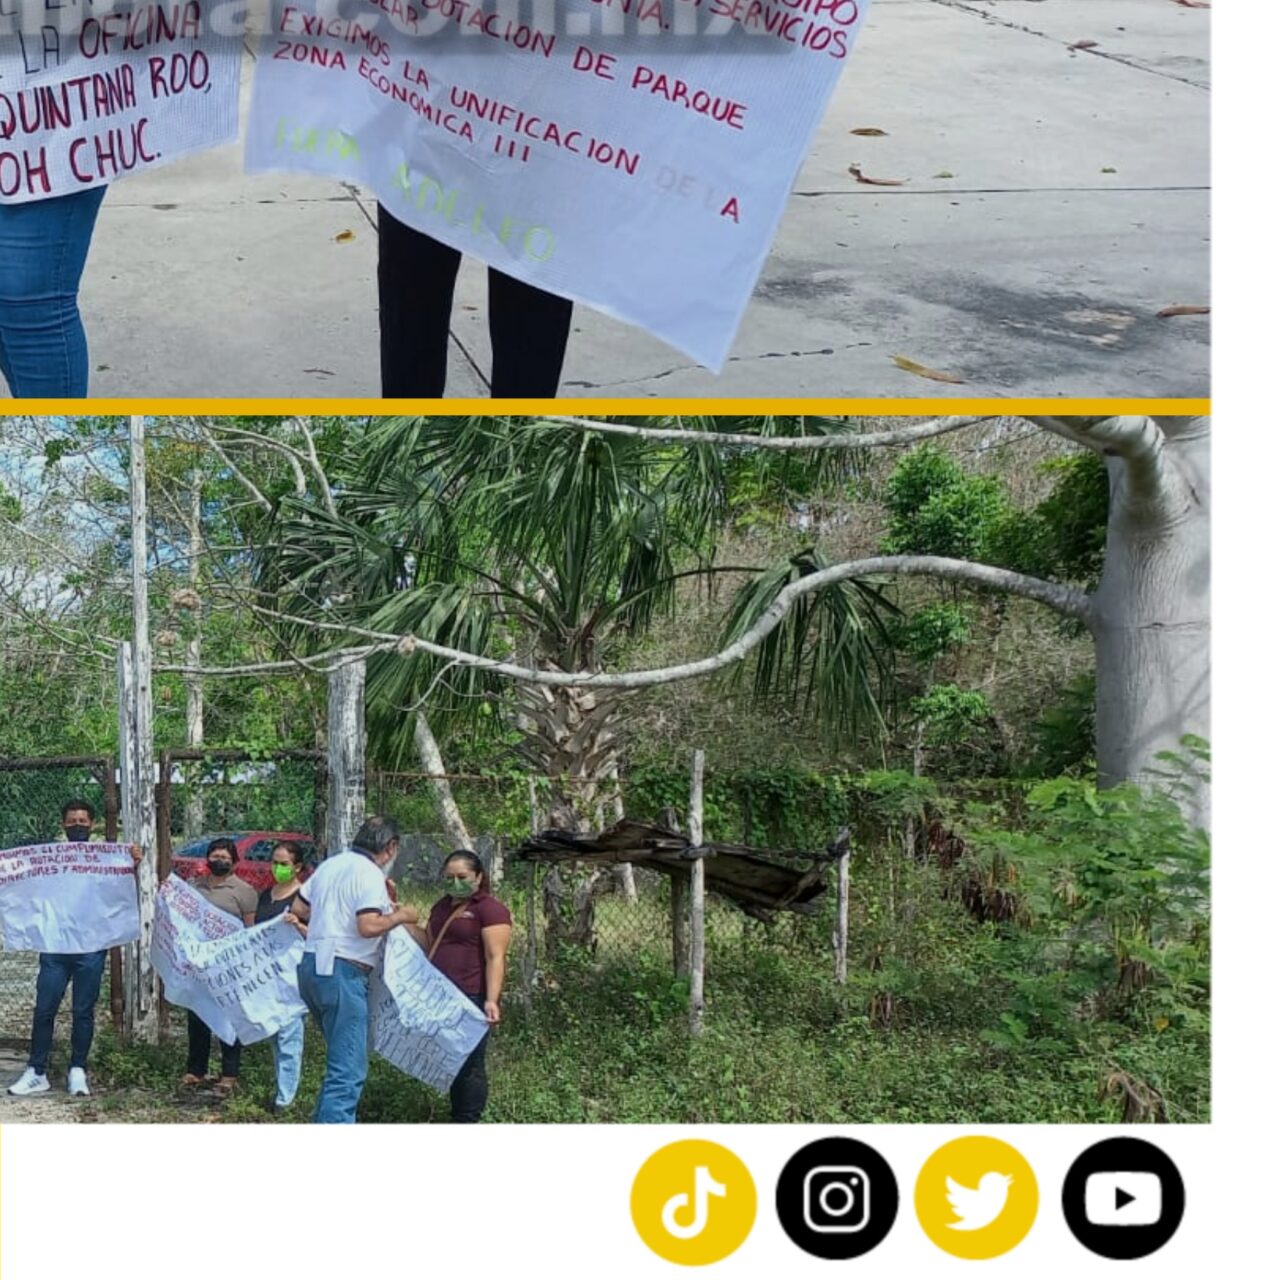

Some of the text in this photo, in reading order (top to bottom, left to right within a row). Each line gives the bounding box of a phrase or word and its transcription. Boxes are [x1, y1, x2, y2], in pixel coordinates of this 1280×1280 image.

[23, 27, 60, 73] LA
[78, 1, 200, 60] OFICINA
[274, 42, 475, 143] ZONA ECONOMICA
[280, 7, 640, 174] EXIGIMOS LA UNIFICACION
[573, 46, 616, 80] DE
[632, 66, 748, 129] PARQUE
[69, 119, 161, 183] CHUC.
